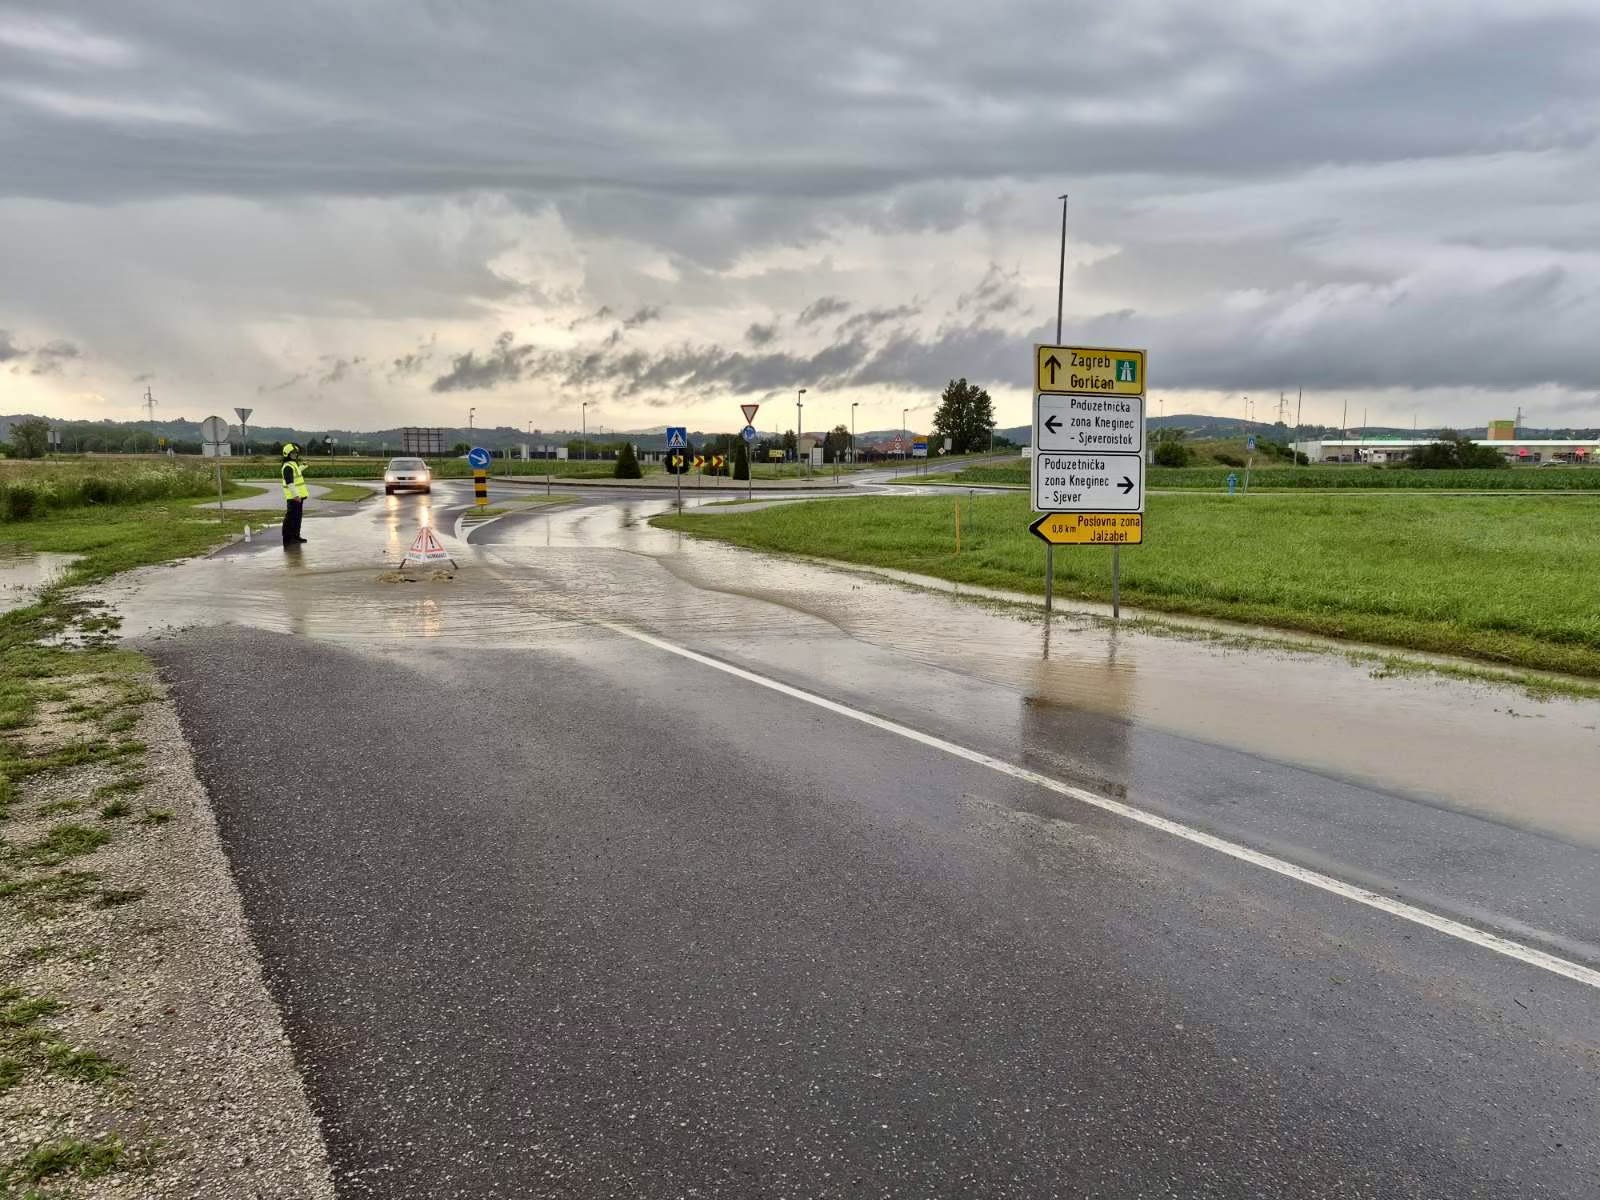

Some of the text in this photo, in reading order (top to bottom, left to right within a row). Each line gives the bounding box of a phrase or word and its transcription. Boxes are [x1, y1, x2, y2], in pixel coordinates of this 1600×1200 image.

[1071, 352, 1110, 370] Zagreb
[1070, 374, 1114, 390] Goričan
[1070, 416, 1134, 430] zona Kneginec
[1078, 432, 1132, 446] Sjeveroistok
[1044, 458, 1105, 470] Poduzetnička
[1044, 474, 1110, 489] zona Kneginec
[1053, 490, 1082, 504] Sjever
[1078, 514, 1140, 526] Poslovna zona
[1064, 525, 1076, 533] km
